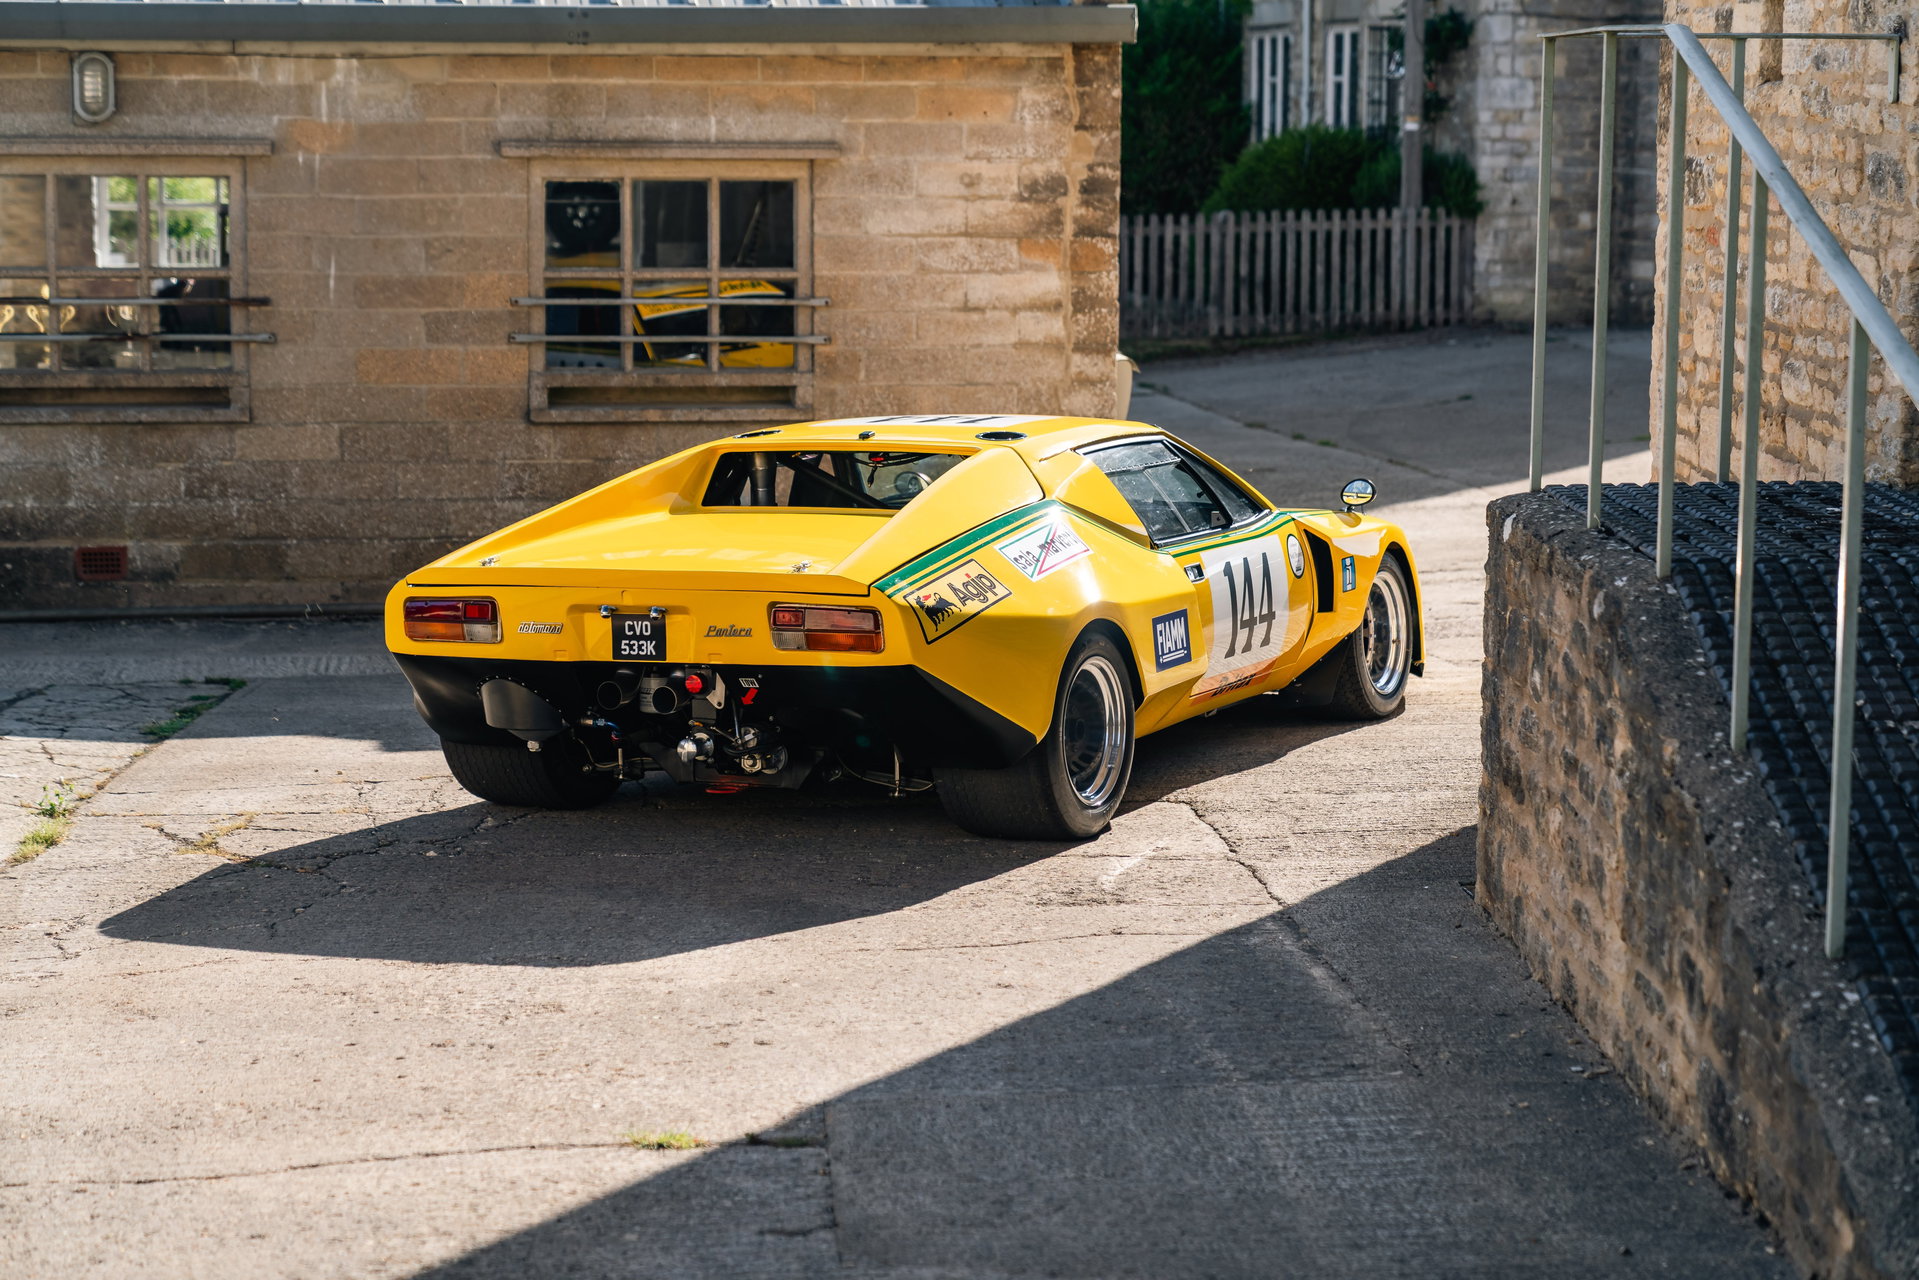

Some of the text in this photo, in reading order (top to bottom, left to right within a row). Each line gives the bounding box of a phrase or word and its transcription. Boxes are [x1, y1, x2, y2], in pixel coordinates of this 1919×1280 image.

[947, 573, 998, 607] Agip
[1223, 552, 1276, 660] 144
[624, 620, 651, 636] CVO
[704, 624, 752, 637] Pantera
[1156, 617, 1187, 656] FIAMM
[621, 640, 656, 655] 533K
[740, 678, 758, 688] TOW
